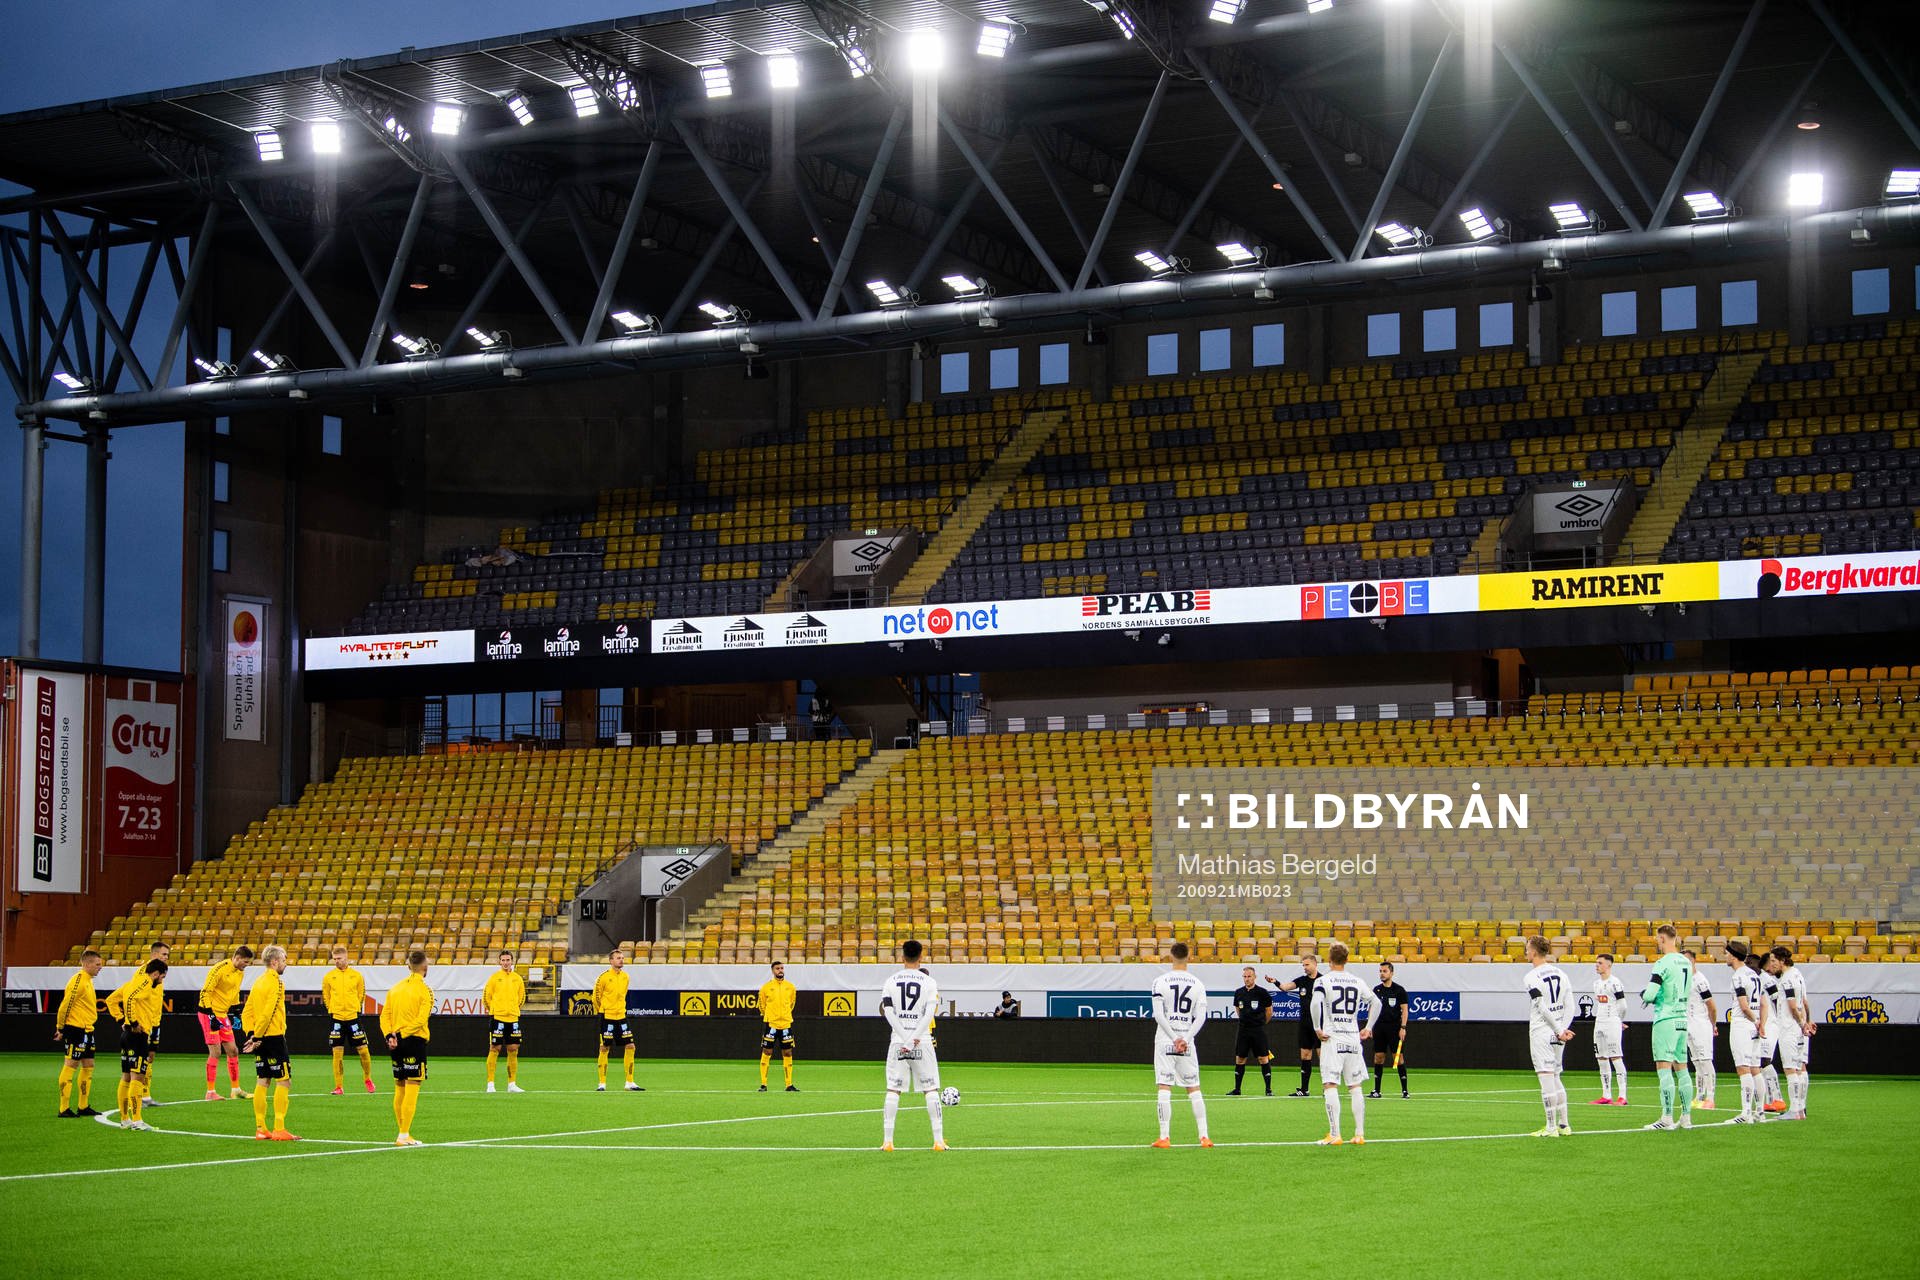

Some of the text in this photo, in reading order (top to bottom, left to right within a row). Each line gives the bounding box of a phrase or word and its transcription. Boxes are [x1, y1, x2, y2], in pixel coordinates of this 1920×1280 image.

[1560, 518, 1599, 529] umbro
[855, 562, 881, 572] umbr
[1532, 573, 1663, 601] RAMIRENT
[1096, 591, 1195, 616] PEAB
[1082, 621, 1122, 630] NORDENS
[340, 640, 438, 653] KVALITETSFLYTT
[486, 642, 523, 656] lamina
[544, 639, 580, 653] lamina
[602, 636, 639, 650] lamina
[233, 655, 243, 730] Sparbanken
[112, 714, 171, 755] City
[39, 687, 52, 828] BOGSTEDT BIL
[60, 717, 70, 844] www.bogstedtsbil.se
[118, 791, 162, 803] Öppet alla dagar
[118, 806, 161, 831] 7-23
[1543, 975, 1561, 1003] 17
[1682, 968, 1688, 992] 1
[896, 981, 921, 1011] 19
[1170, 985, 1192, 1013] 16
[1332, 986, 1358, 1014] 28
[1409, 997, 1454, 1013] Svets
[1834, 997, 1883, 1017] Blomster
